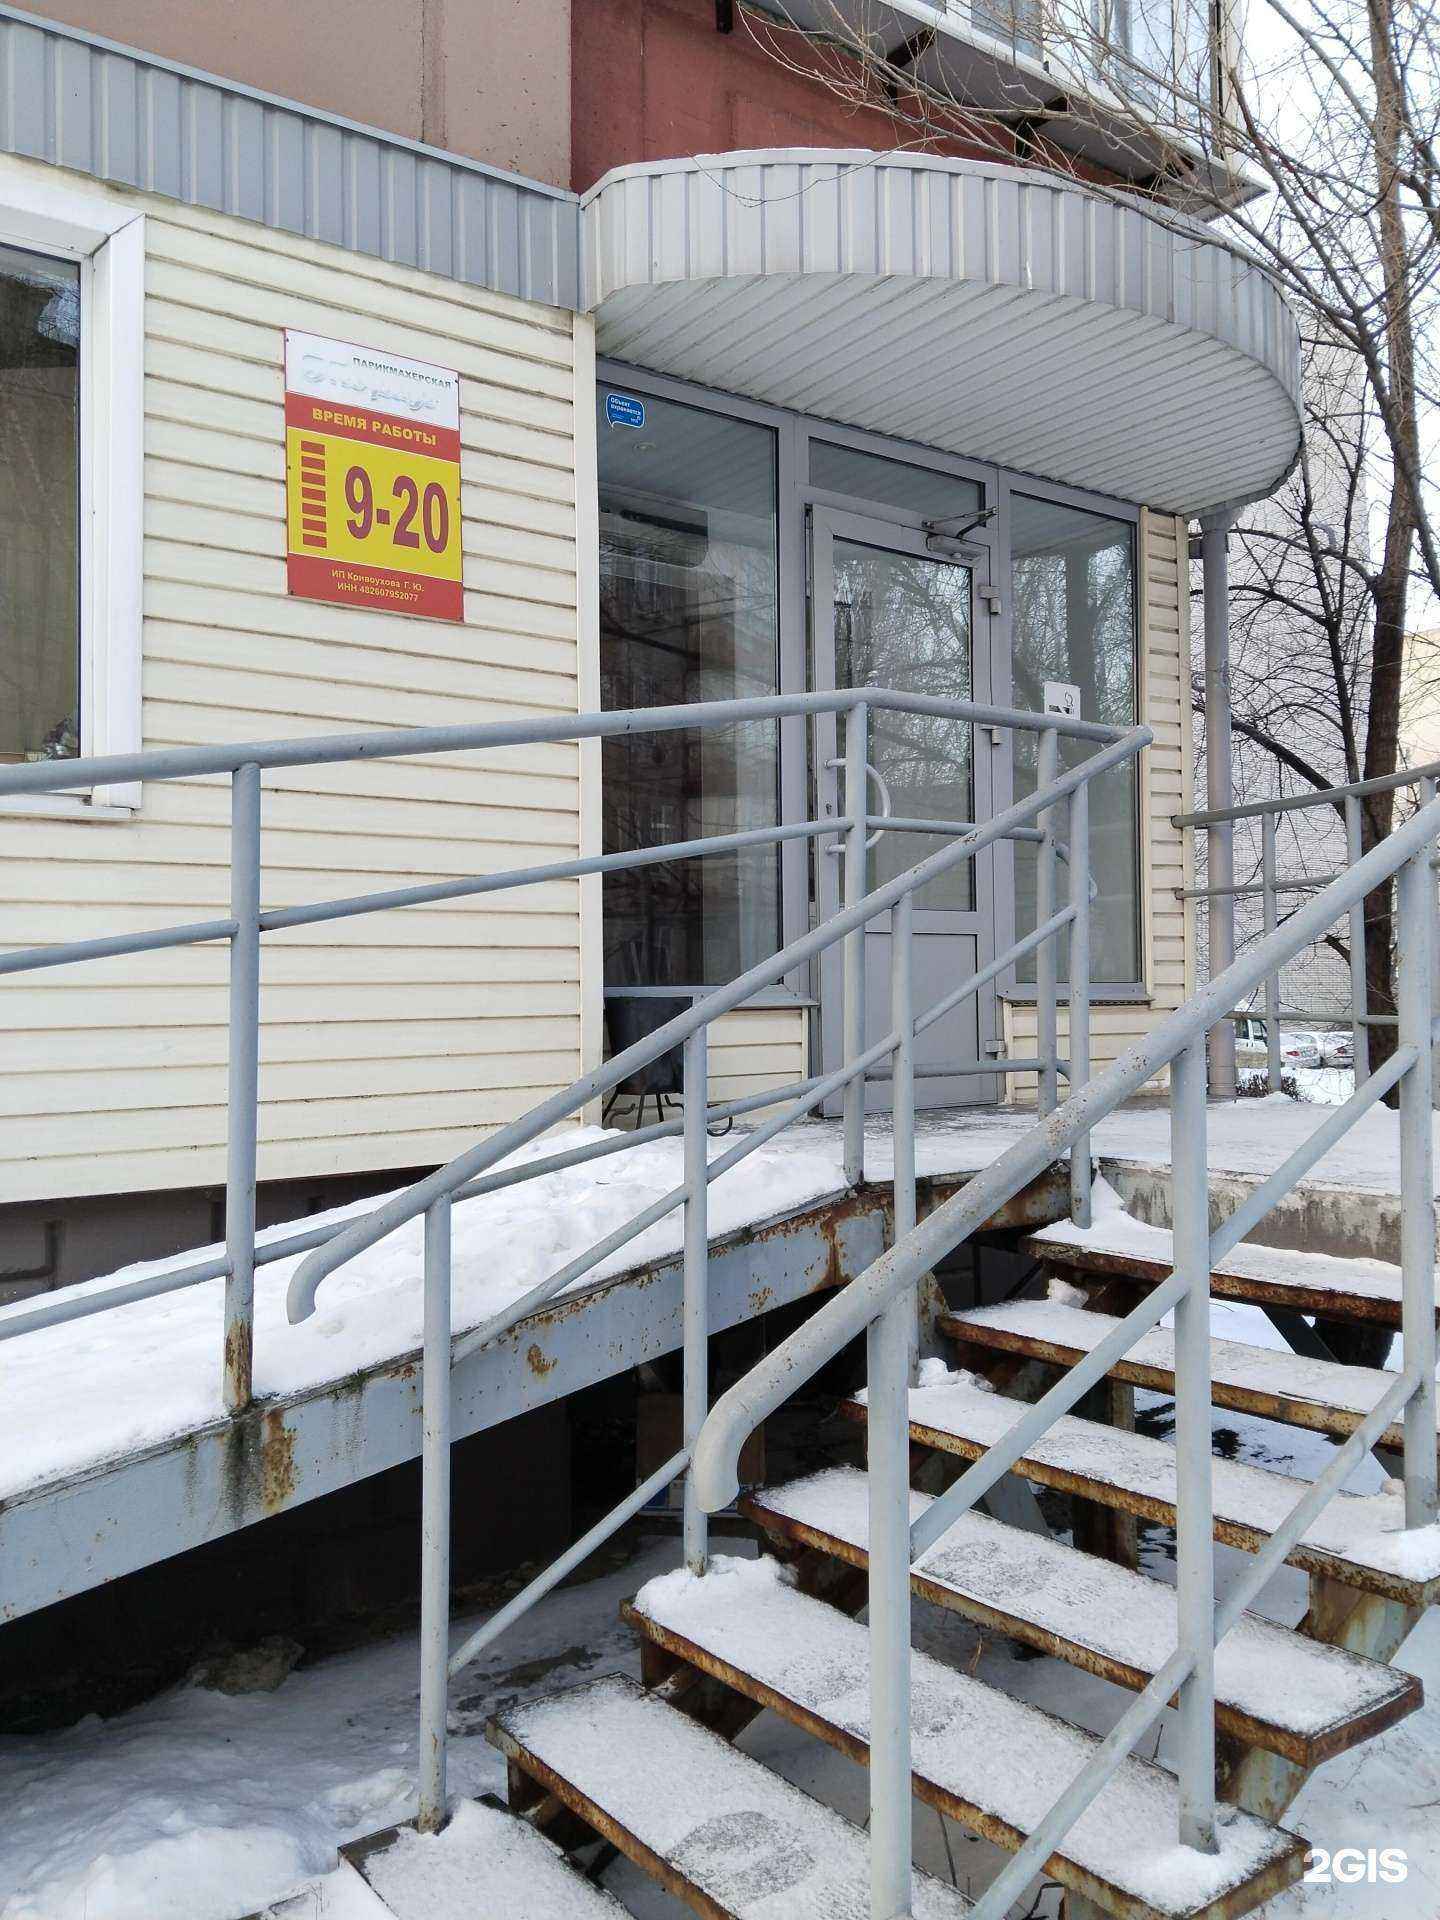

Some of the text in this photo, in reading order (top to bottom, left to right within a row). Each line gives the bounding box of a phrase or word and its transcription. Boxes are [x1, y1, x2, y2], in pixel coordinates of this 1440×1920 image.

[353, 356, 452, 389] ПАРИКМАХЕРСКАЯ
[312, 407, 437, 446] ВРЕМЯ РАБОТЫ
[345, 465, 449, 554] 9-20
[331, 568, 345, 579] ИП
[347, 571, 401, 588] Кривоухова
[336, 581, 419, 602] ИНН 482607952077
